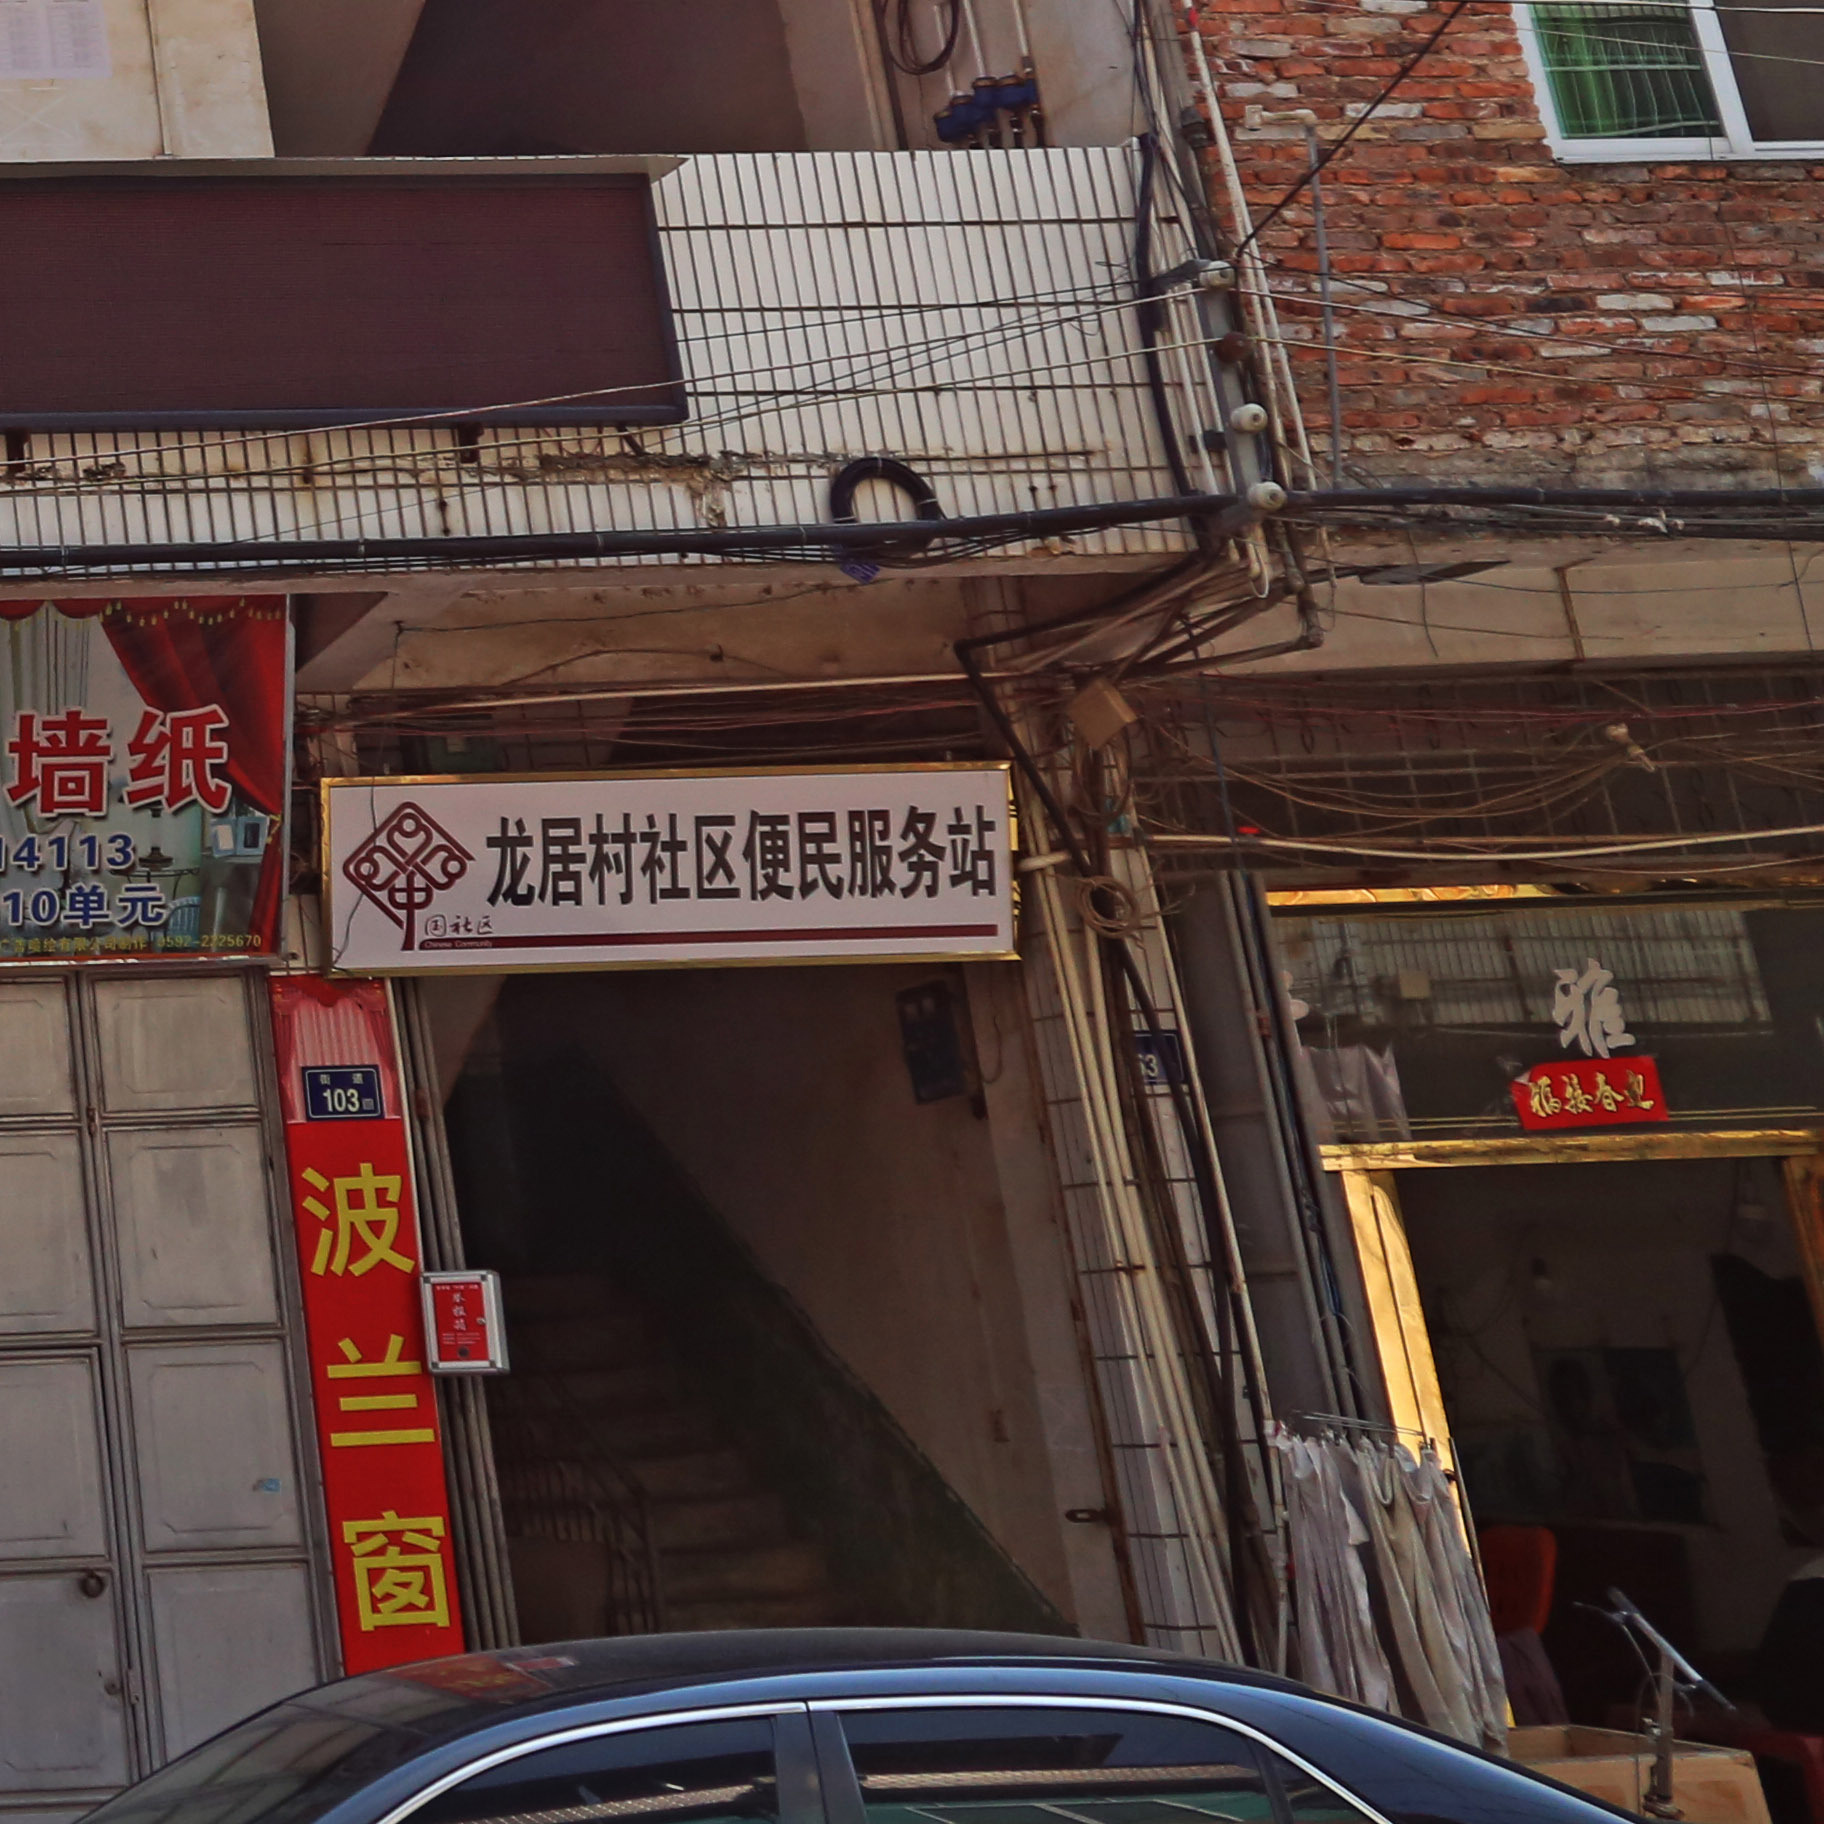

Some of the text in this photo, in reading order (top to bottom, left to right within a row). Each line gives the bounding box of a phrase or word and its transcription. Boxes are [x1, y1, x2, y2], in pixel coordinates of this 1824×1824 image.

[5, 701, 238, 820] 墙纸
[485, 804, 998, 908] 龙居村社区便民服务站
[323, 1088, 360, 1113] 103
[301, 1162, 452, 1632] 波兰窗
